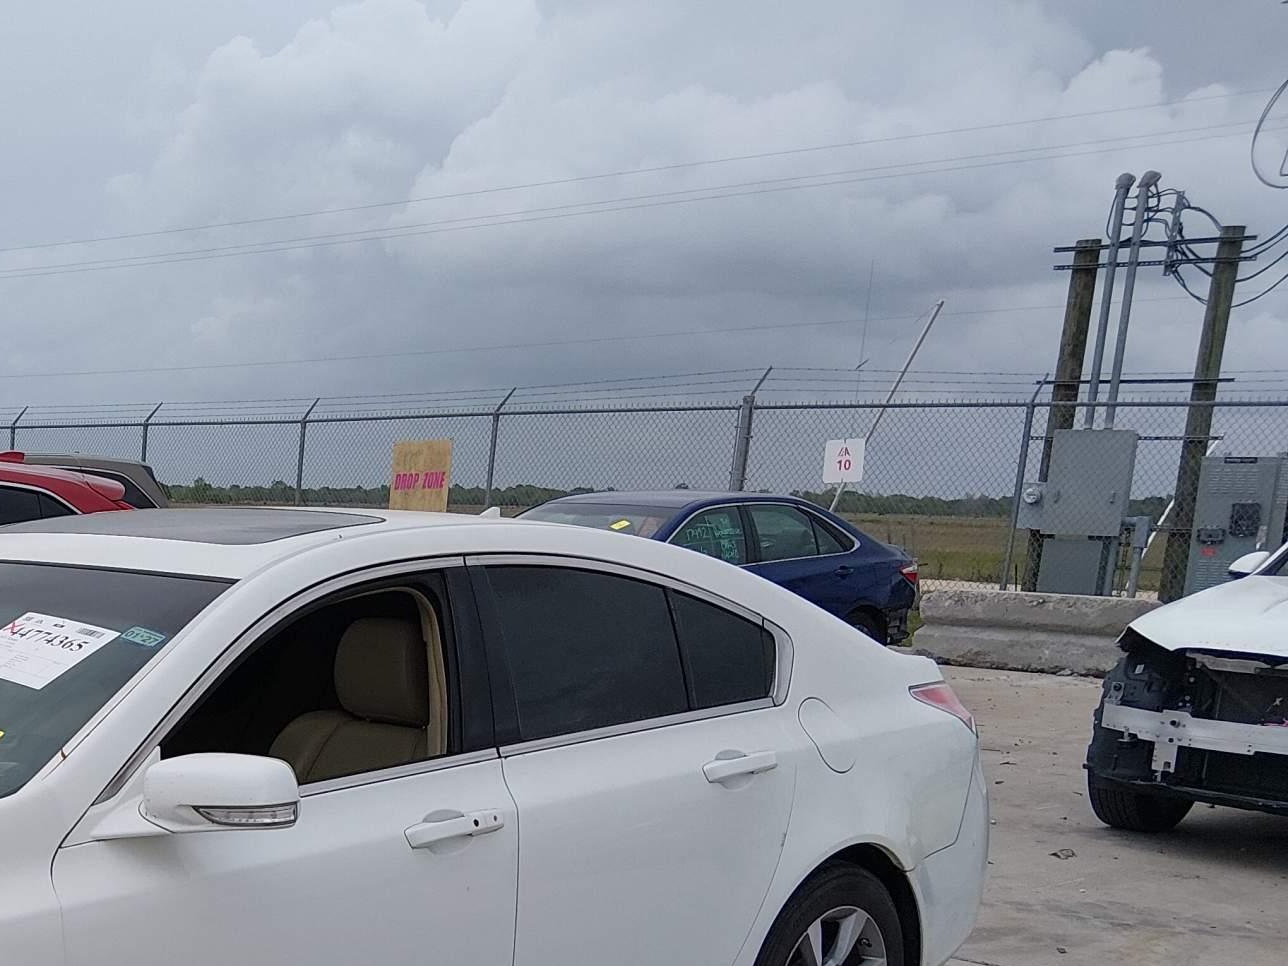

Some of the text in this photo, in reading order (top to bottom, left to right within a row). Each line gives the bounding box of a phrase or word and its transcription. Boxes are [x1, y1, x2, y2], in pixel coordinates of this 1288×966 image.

[836, 459, 852, 471] 10
[394, 472, 445, 490] DROP ZONE
[11, 627, 89, 651] 44774365
